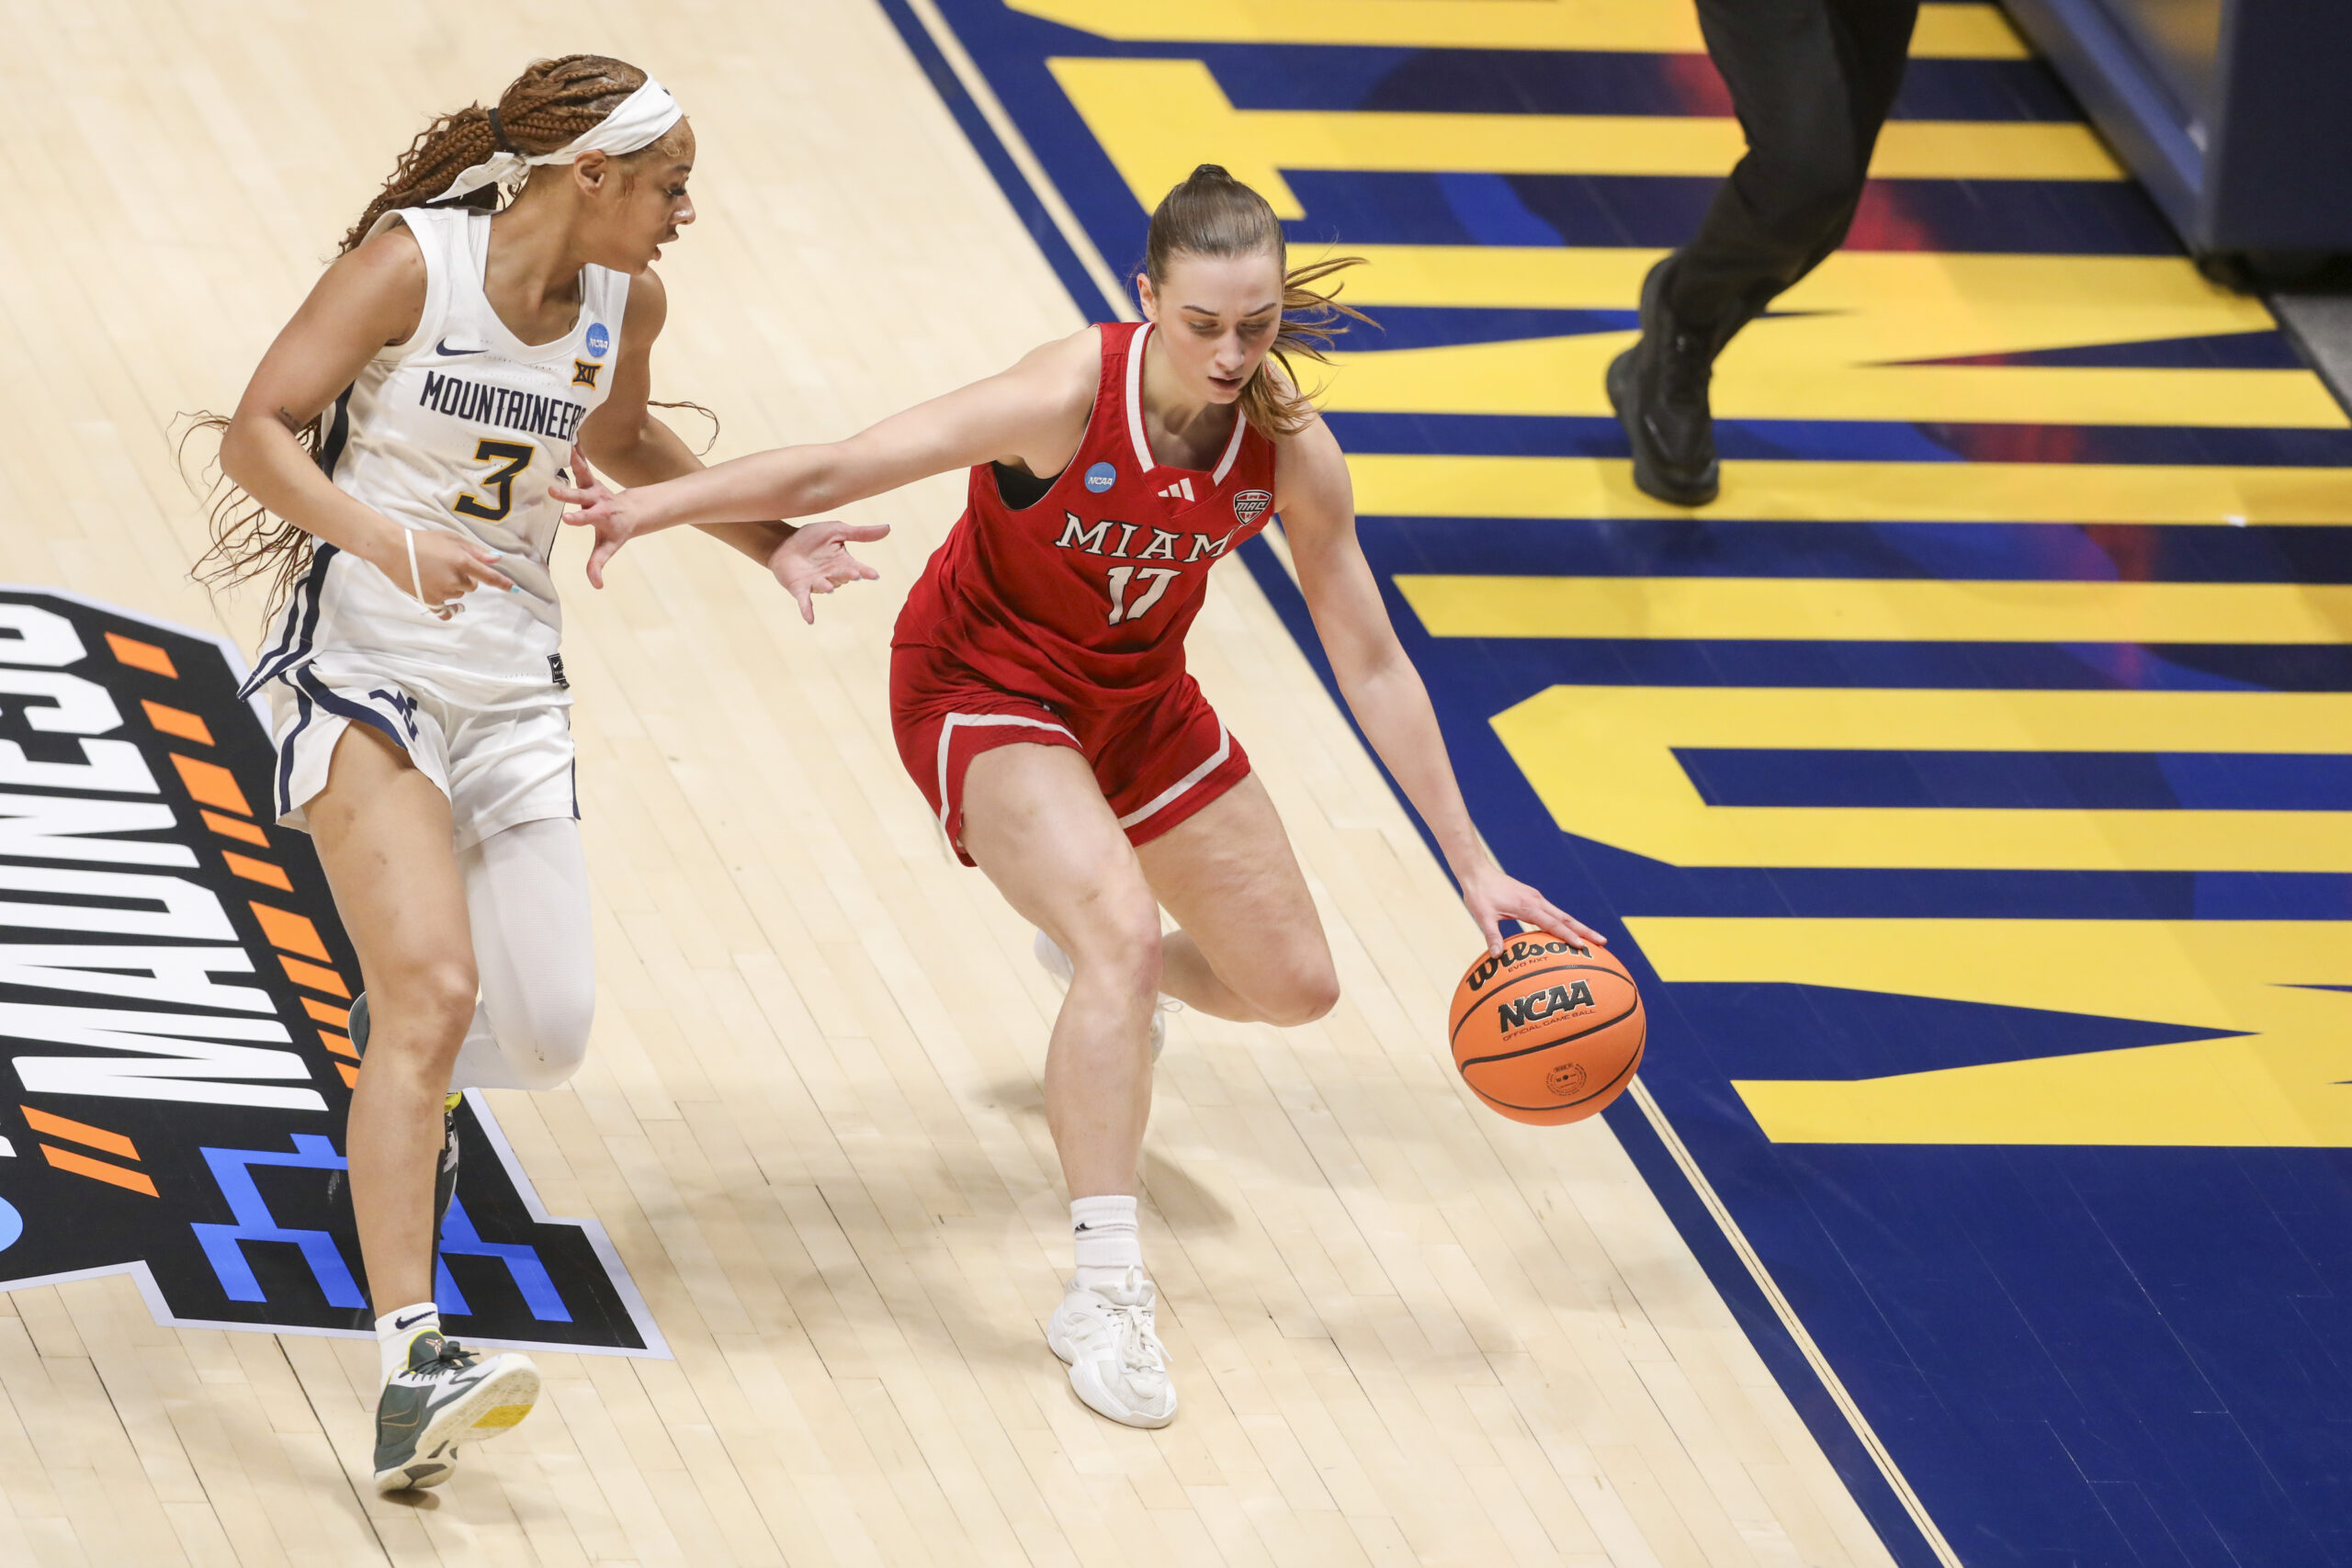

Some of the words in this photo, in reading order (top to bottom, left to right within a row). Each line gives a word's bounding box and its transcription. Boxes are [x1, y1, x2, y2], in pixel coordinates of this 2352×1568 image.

[590, 337, 608, 349] NCAA
[452, 438, 536, 522] 3
[1087, 476, 1114, 486] NCAA
[1236, 502, 1266, 511] MAC
[1105, 566, 1182, 626] 17
[1508, 962, 1527, 973] EVO
[1529, 956, 1549, 964] NXT
[1498, 979, 1595, 1034] NCAA
[1503, 1024, 1542, 1042] OFFICIAL
[1543, 1014, 1571, 1026] GAME
[1572, 1009, 1596, 1019] BALL
